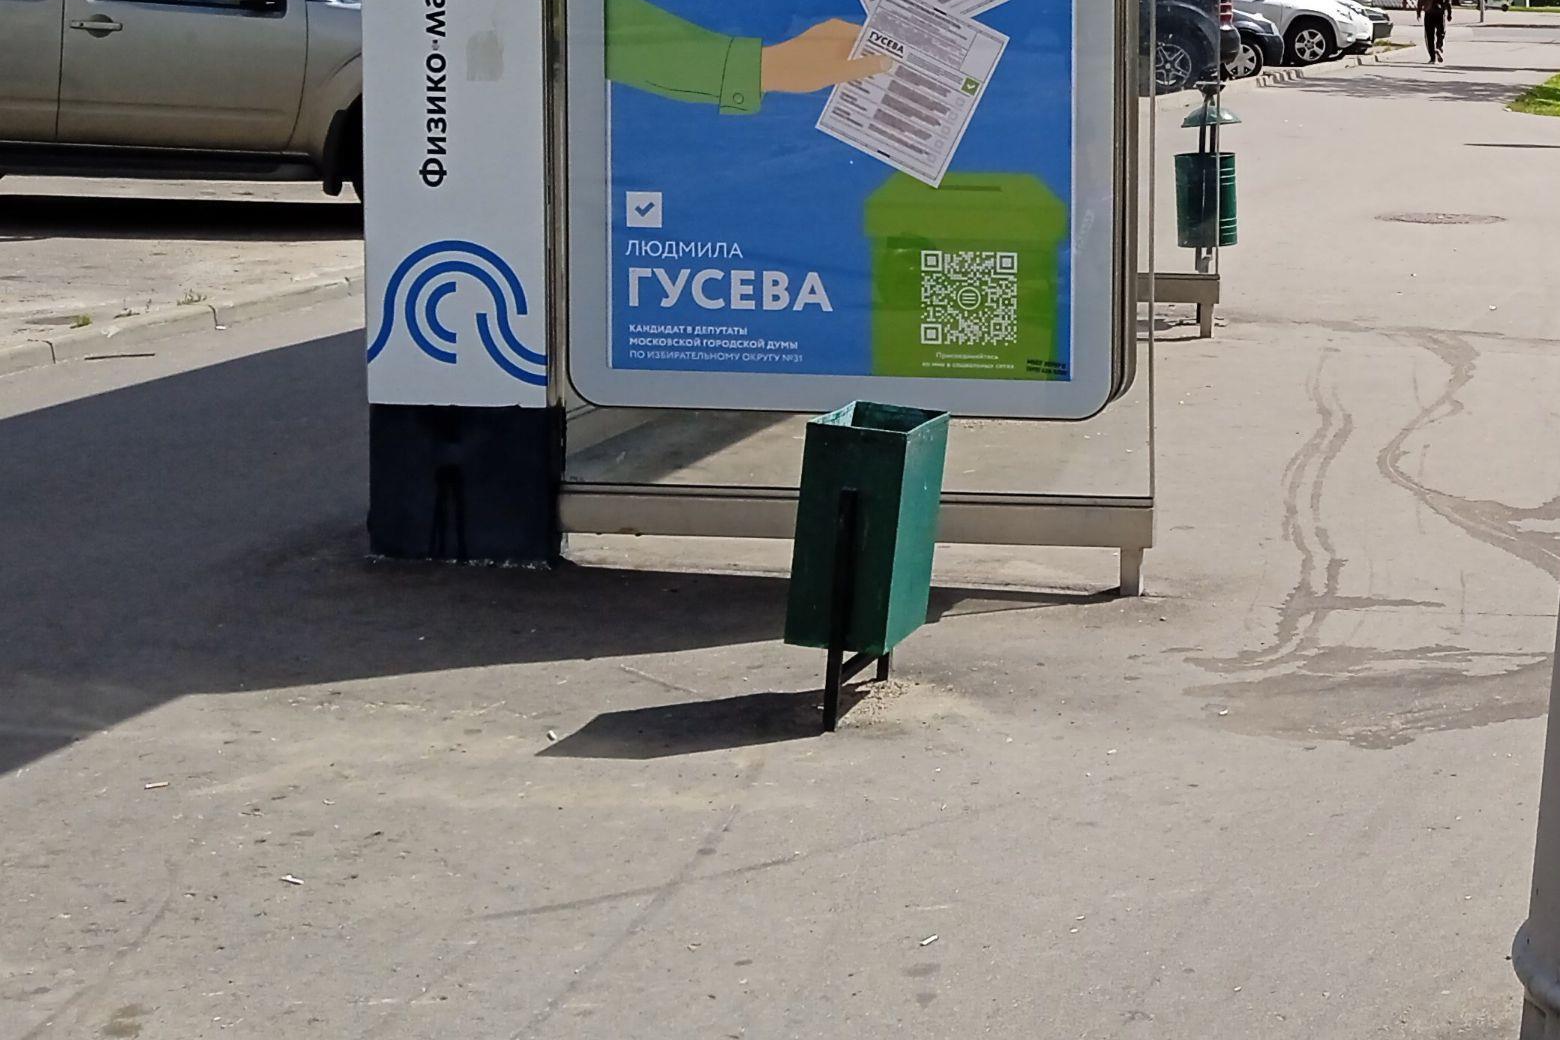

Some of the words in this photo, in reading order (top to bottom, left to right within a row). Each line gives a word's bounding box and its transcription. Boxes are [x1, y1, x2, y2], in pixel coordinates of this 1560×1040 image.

[869, 30, 905, 55] ГУСЕВА
[625, 239, 744, 260] ЛЮДМИЛА
[628, 266, 834, 313] ГУСЕВА
[629, 324, 687, 335] КАНДИДАТ
[694, 325, 748, 336] ДЕПУТАТЫ
[629, 336, 701, 347] МОСКОВСКОЙ
[703, 338, 765, 349] ГОРОДСКОЙ
[766, 340, 798, 350] ДУМЫ
[629, 350, 645, 359] ПО
[647, 350, 741, 361] ИЗБИРАТЕЛЬНОМУ
[742, 352, 780, 362] ОКРУГУ
